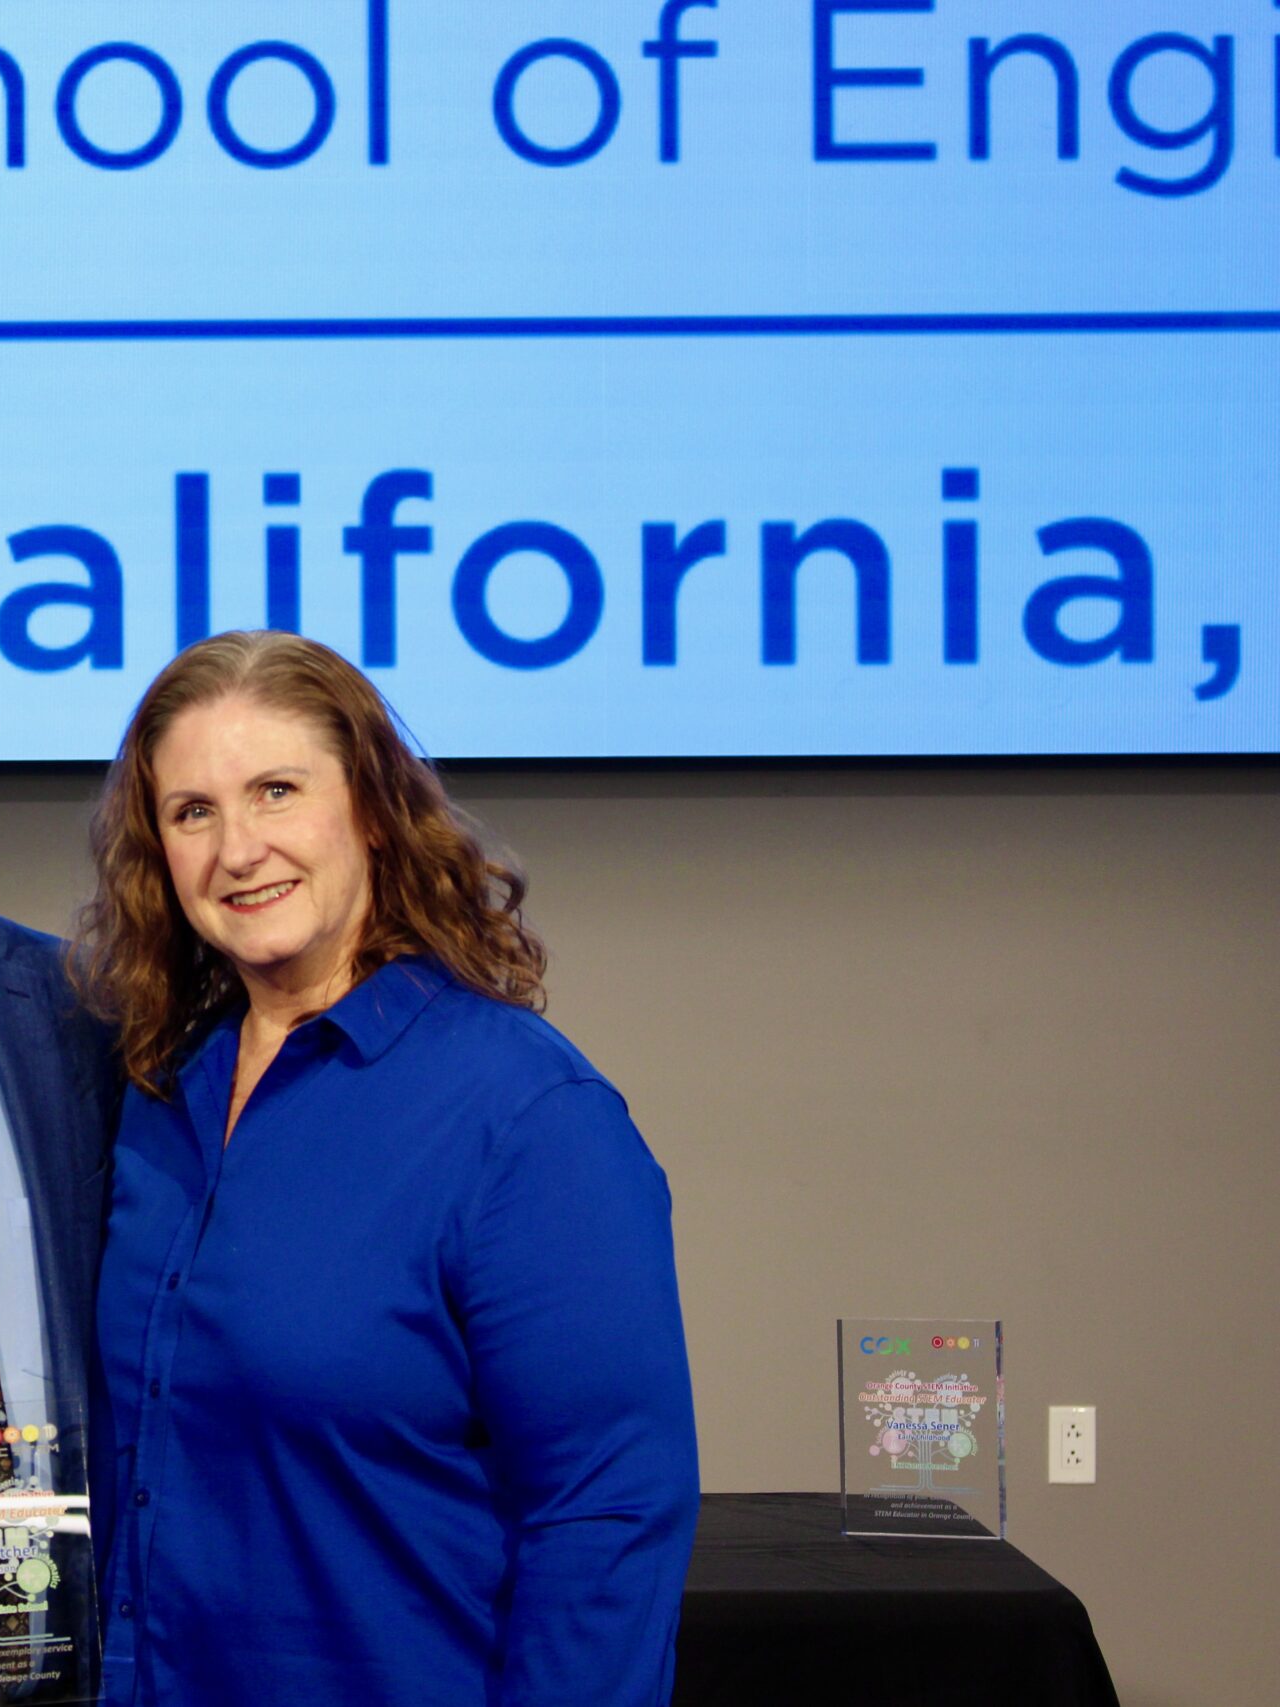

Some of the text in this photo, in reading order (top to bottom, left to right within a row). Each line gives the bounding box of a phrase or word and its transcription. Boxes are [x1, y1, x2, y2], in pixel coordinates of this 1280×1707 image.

[492, 0, 719, 168] of
[860, 1336, 912, 1356] COX
[865, 1382, 894, 1392] Orange
[895, 1382, 921, 1392] County
[945, 1383, 979, 1392] Initiative
[945, 1394, 987, 1405] Educator
[886, 1420, 960, 1431] Vanessa Sener
[9, 1506, 68, 1519] Educator
[874, 1510, 892, 1518] STEM
[928, 1512, 952, 1521] Orange
[41, 1643, 74, 1654] service
[17, 1660, 28, 1669] as
[29, 1670, 61, 1682] County
